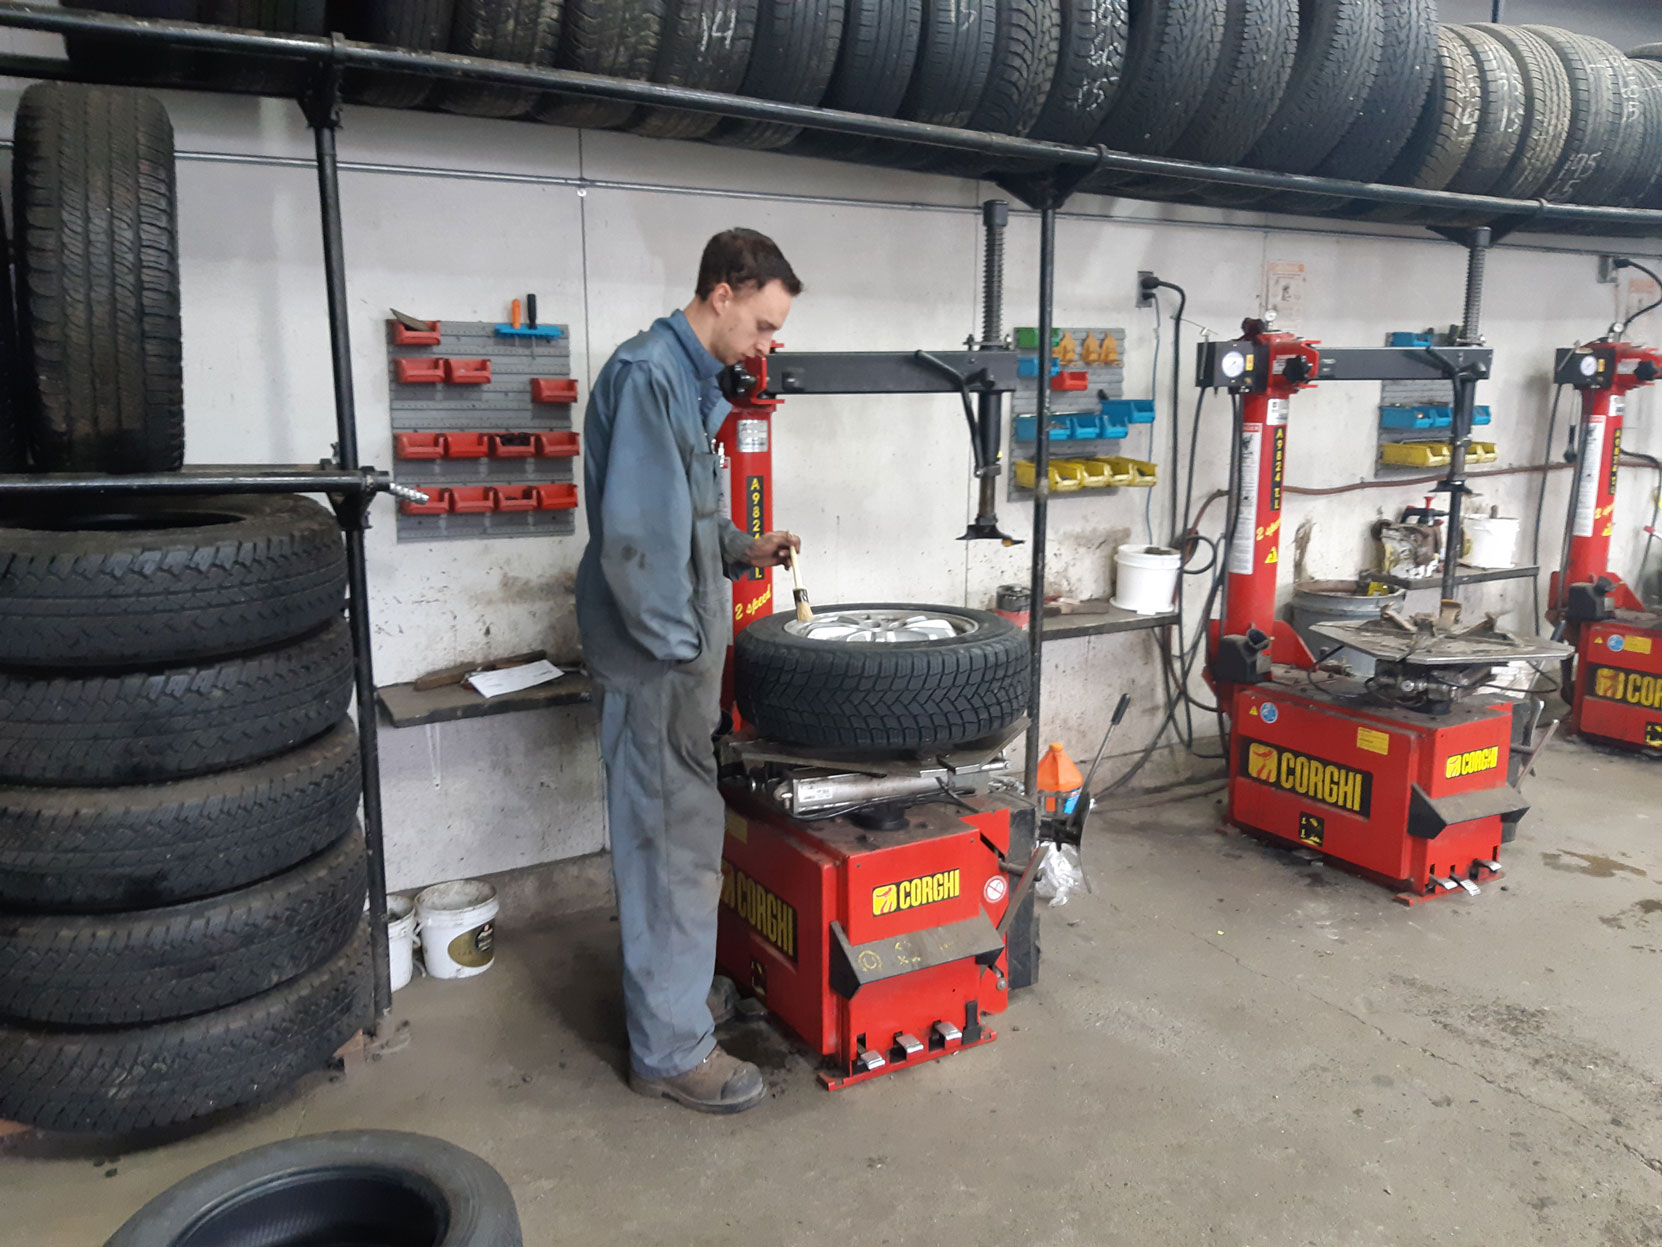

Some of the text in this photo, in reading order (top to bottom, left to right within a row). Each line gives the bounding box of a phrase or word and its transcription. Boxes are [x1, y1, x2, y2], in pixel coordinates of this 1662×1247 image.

[701, 9, 736, 52] 14
[735, 602, 744, 621] 2
[746, 583, 772, 616] speed
[1280, 752, 1363, 811] CORGHI
[1461, 746, 1499, 776] CORGHI
[899, 869, 960, 910] CORGHI
[737, 870, 794, 957] CORGHI
